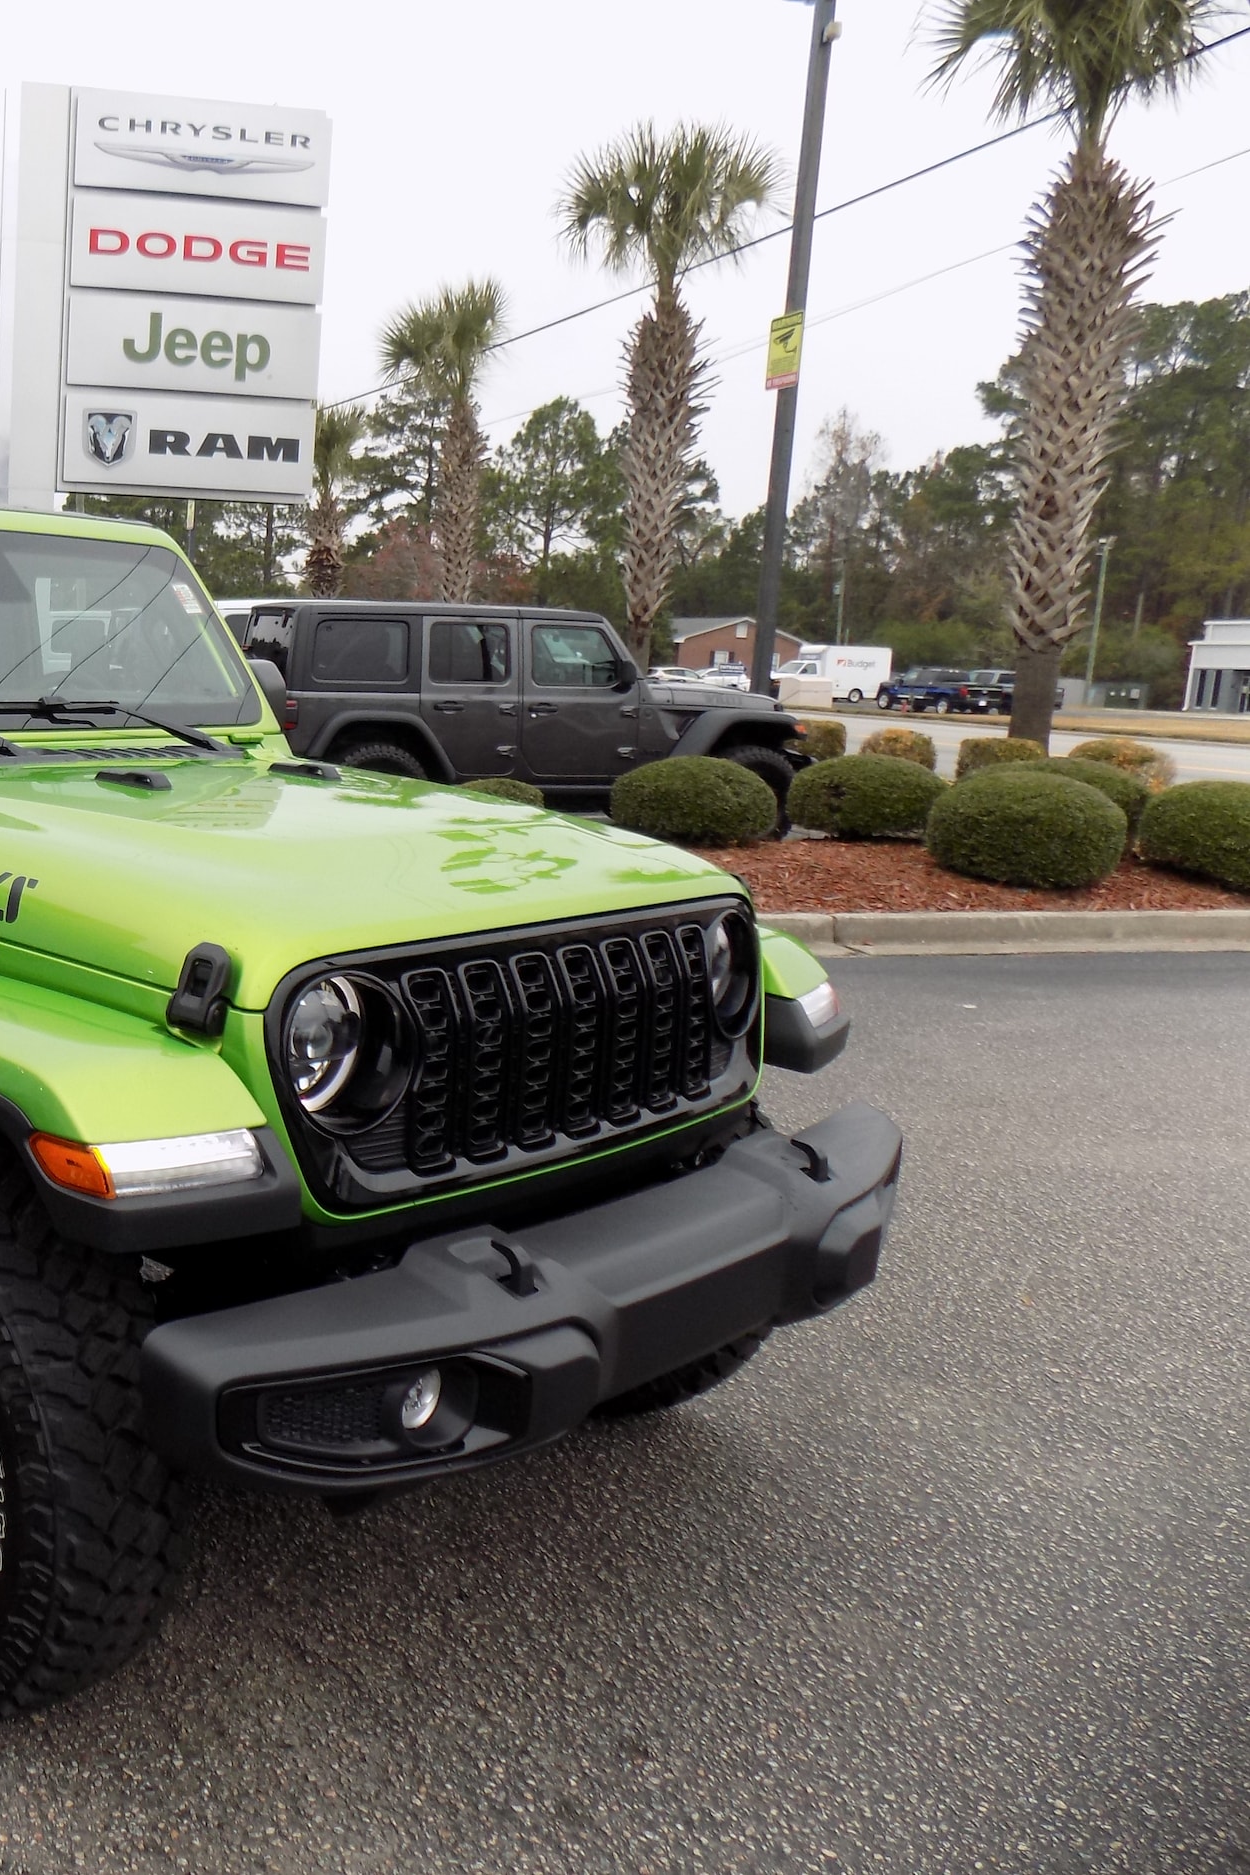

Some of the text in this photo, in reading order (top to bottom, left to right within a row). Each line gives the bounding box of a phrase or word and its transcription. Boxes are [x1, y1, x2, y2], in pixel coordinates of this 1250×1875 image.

[97, 116, 311, 149] CHRYSLER
[88, 228, 311, 272] DODGE
[122, 312, 271, 382] Jeep
[148, 429, 300, 463] RAM
[847, 659, 876, 671] Budget
